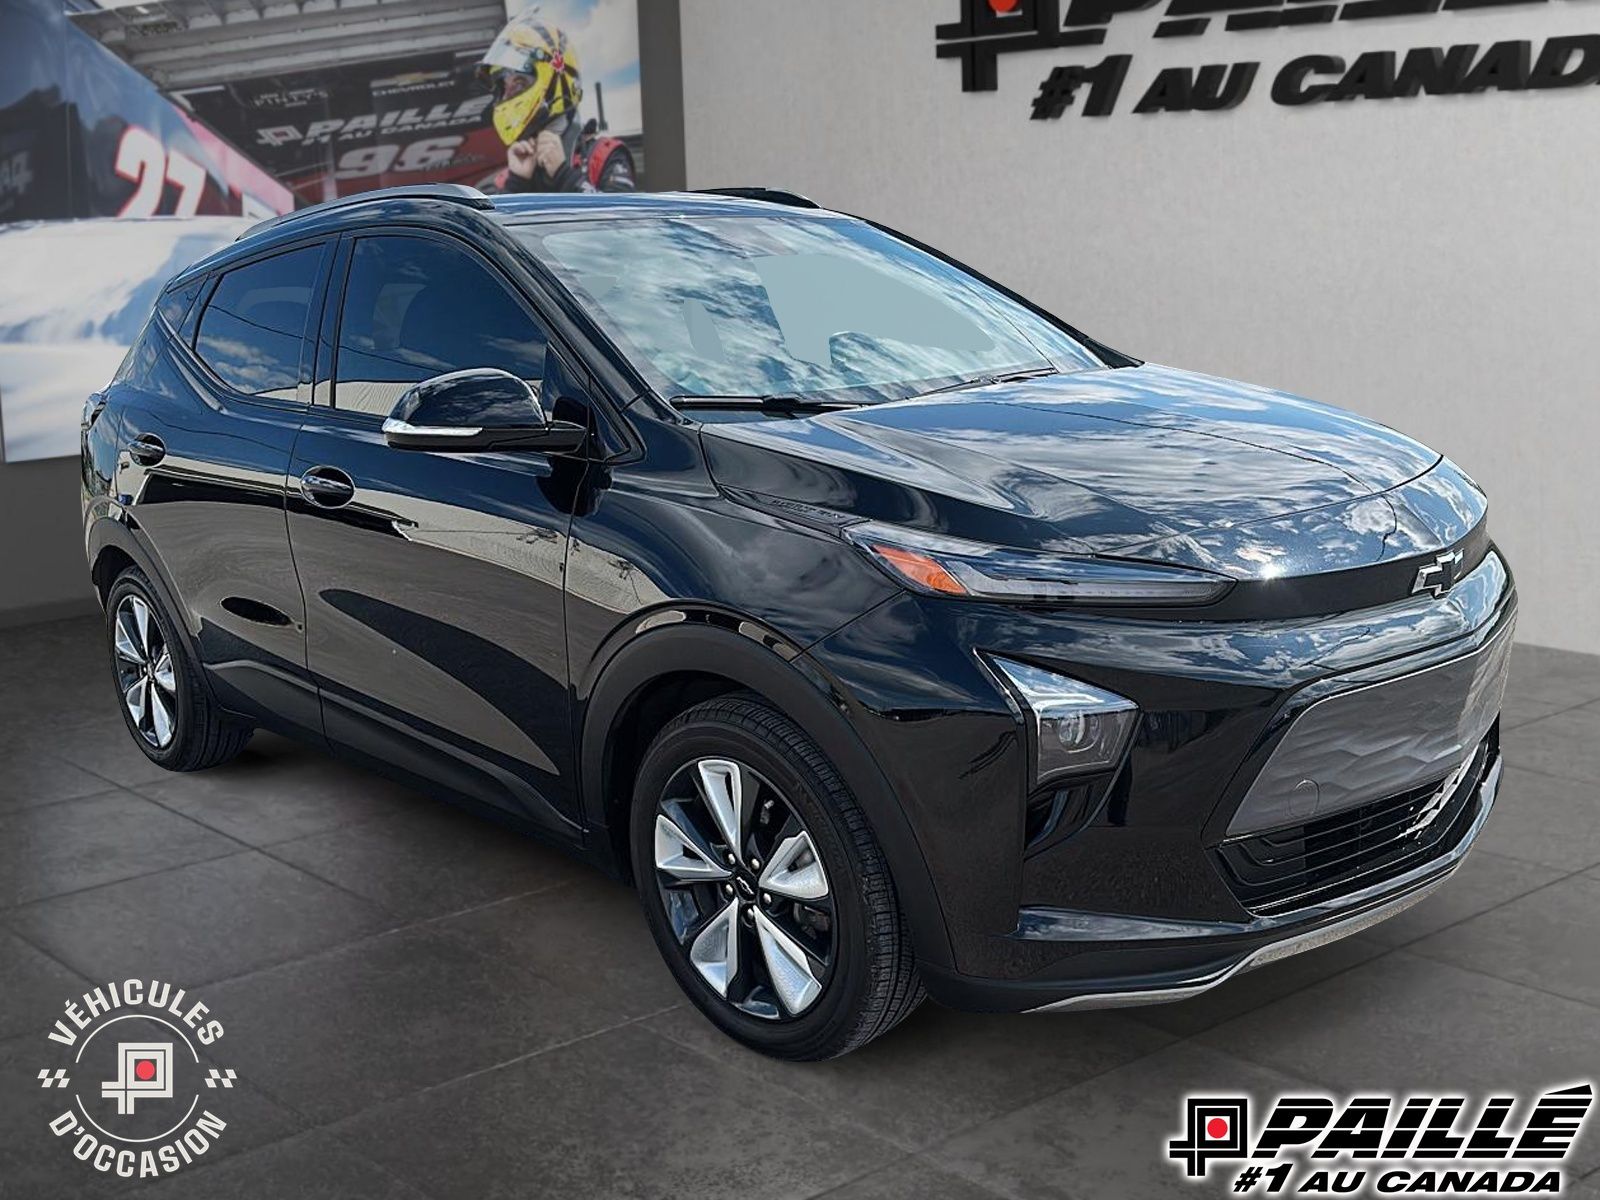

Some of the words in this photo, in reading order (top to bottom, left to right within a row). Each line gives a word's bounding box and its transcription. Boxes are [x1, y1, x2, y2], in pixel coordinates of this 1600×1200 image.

[1029, 54, 1133, 120] #1
[1132, 61, 1260, 114] AU
[1269, 33, 1600, 107] CANAD
[115, 124, 207, 218] 27
[335, 135, 466, 180] 96
